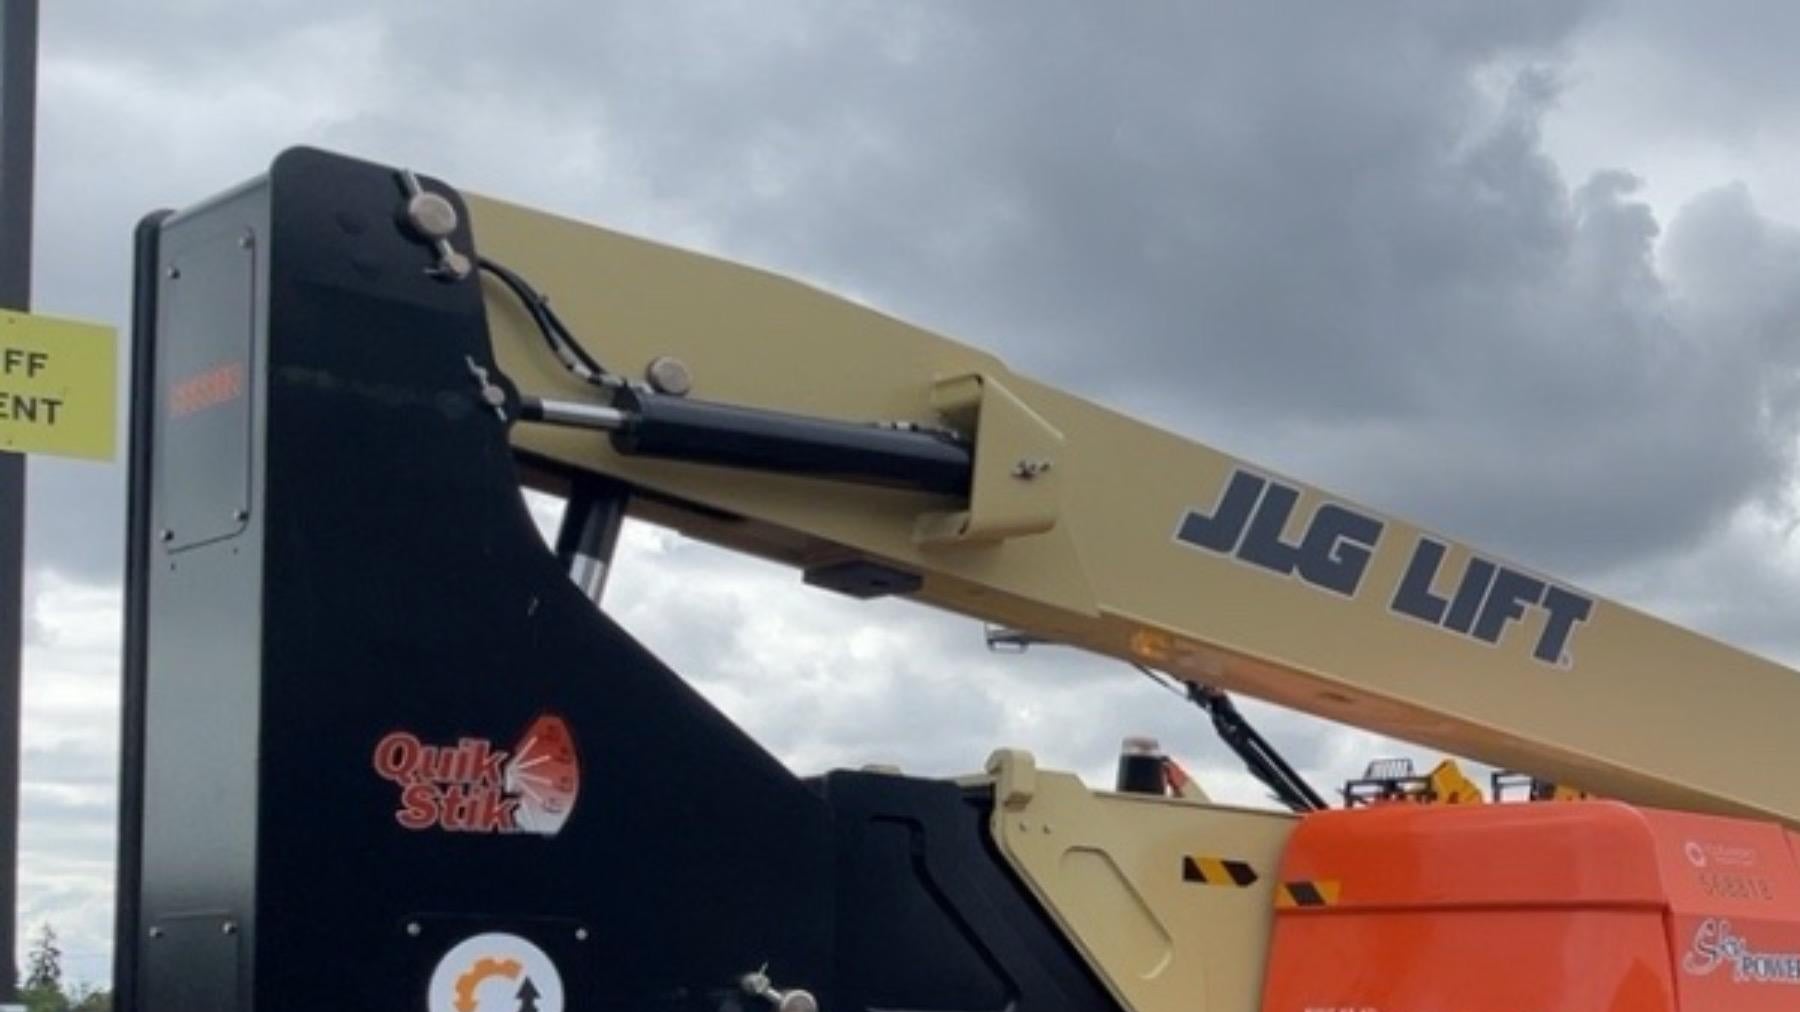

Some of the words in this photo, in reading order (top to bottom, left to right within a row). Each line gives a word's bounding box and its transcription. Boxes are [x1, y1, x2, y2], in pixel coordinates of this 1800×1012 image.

[1176, 469, 1385, 598] JLG
[1389, 536, 1594, 666] LIFT
[374, 732, 508, 787] Quik
[395, 783, 523, 834] Stik
